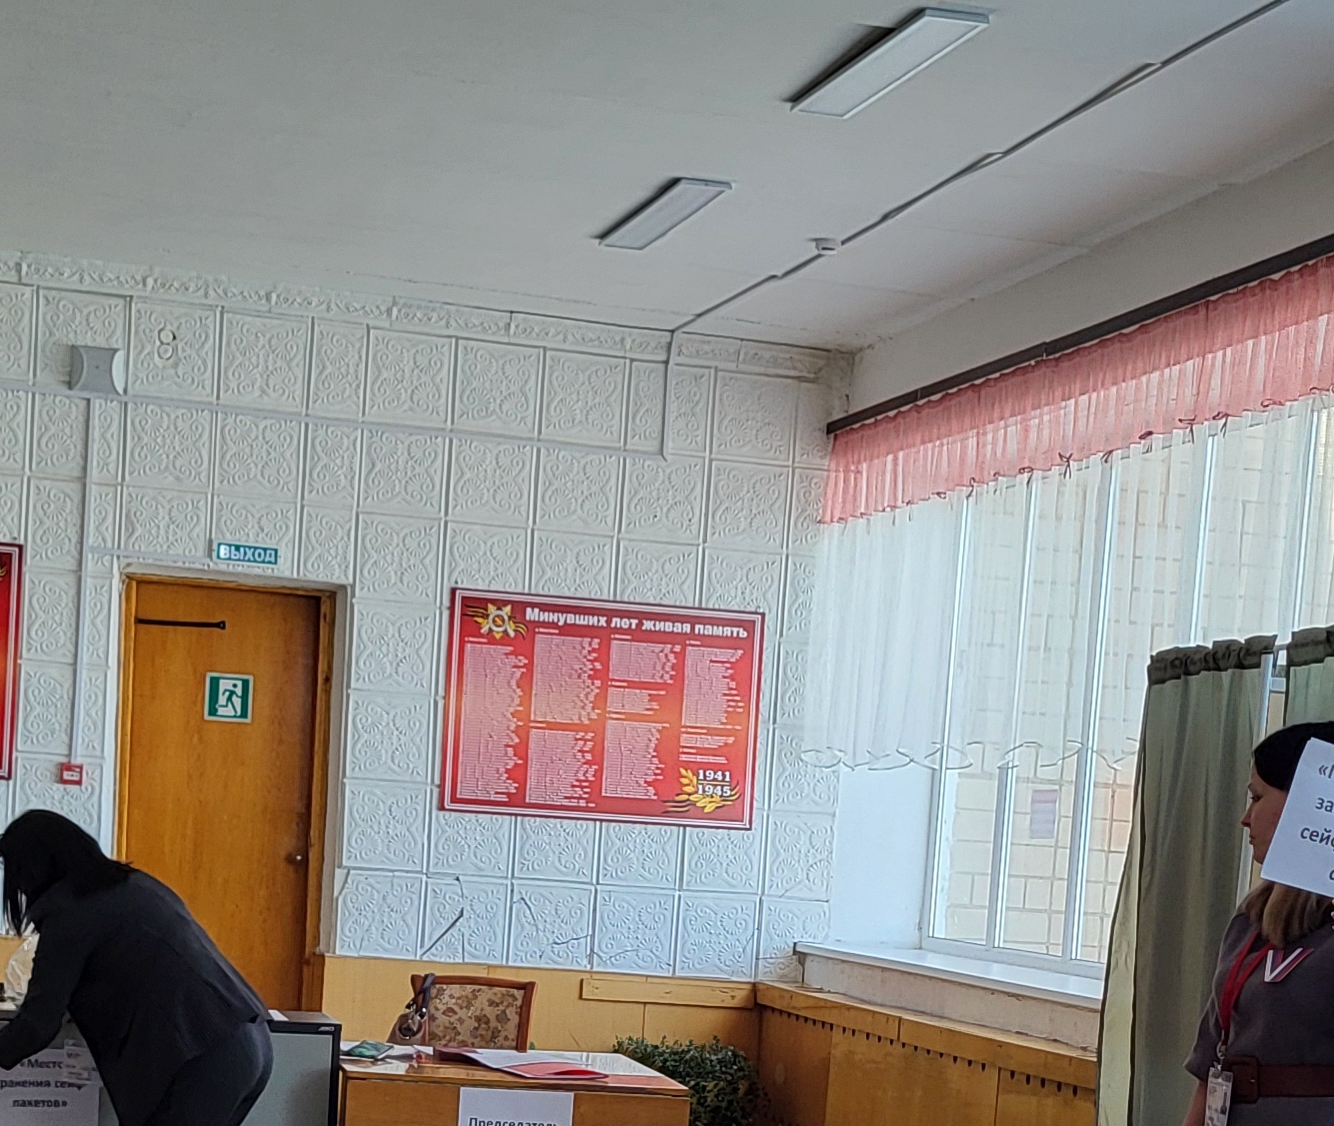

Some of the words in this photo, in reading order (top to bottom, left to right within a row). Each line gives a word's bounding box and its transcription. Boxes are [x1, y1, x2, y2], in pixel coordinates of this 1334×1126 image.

[219, 544, 276, 563] ВЫХОД
[525, 607, 607, 627] Минувших
[611, 616, 638, 630] лет
[641, 619, 691, 634] живая
[694, 625, 748, 638] память
[698, 769, 730, 781] 1941
[698, 784, 731, 796] 1945
